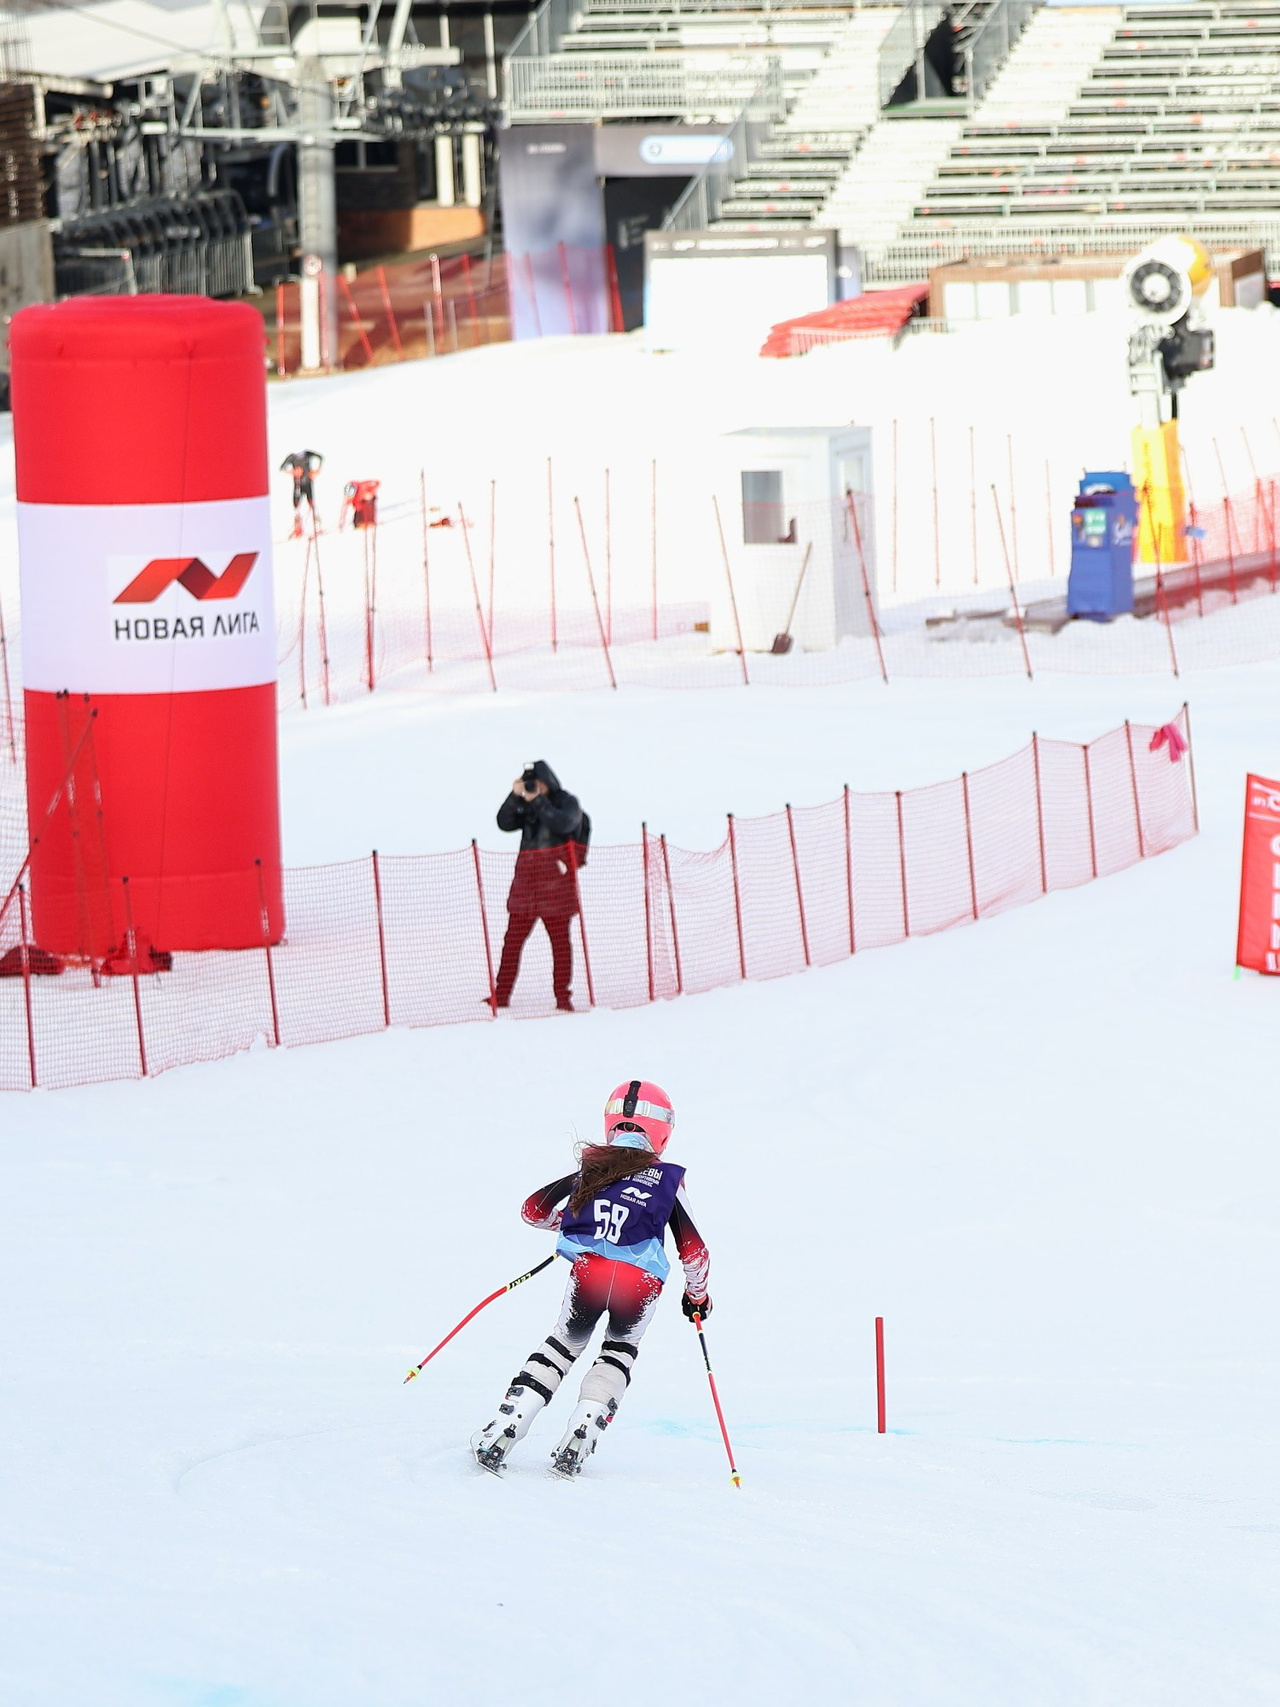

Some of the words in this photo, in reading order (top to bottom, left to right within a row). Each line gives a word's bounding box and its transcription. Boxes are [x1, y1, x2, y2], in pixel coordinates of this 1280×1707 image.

[114, 616, 204, 640] НОВАЯ
[213, 611, 260, 636] ЛИГА
[594, 1199, 630, 1244] 59
